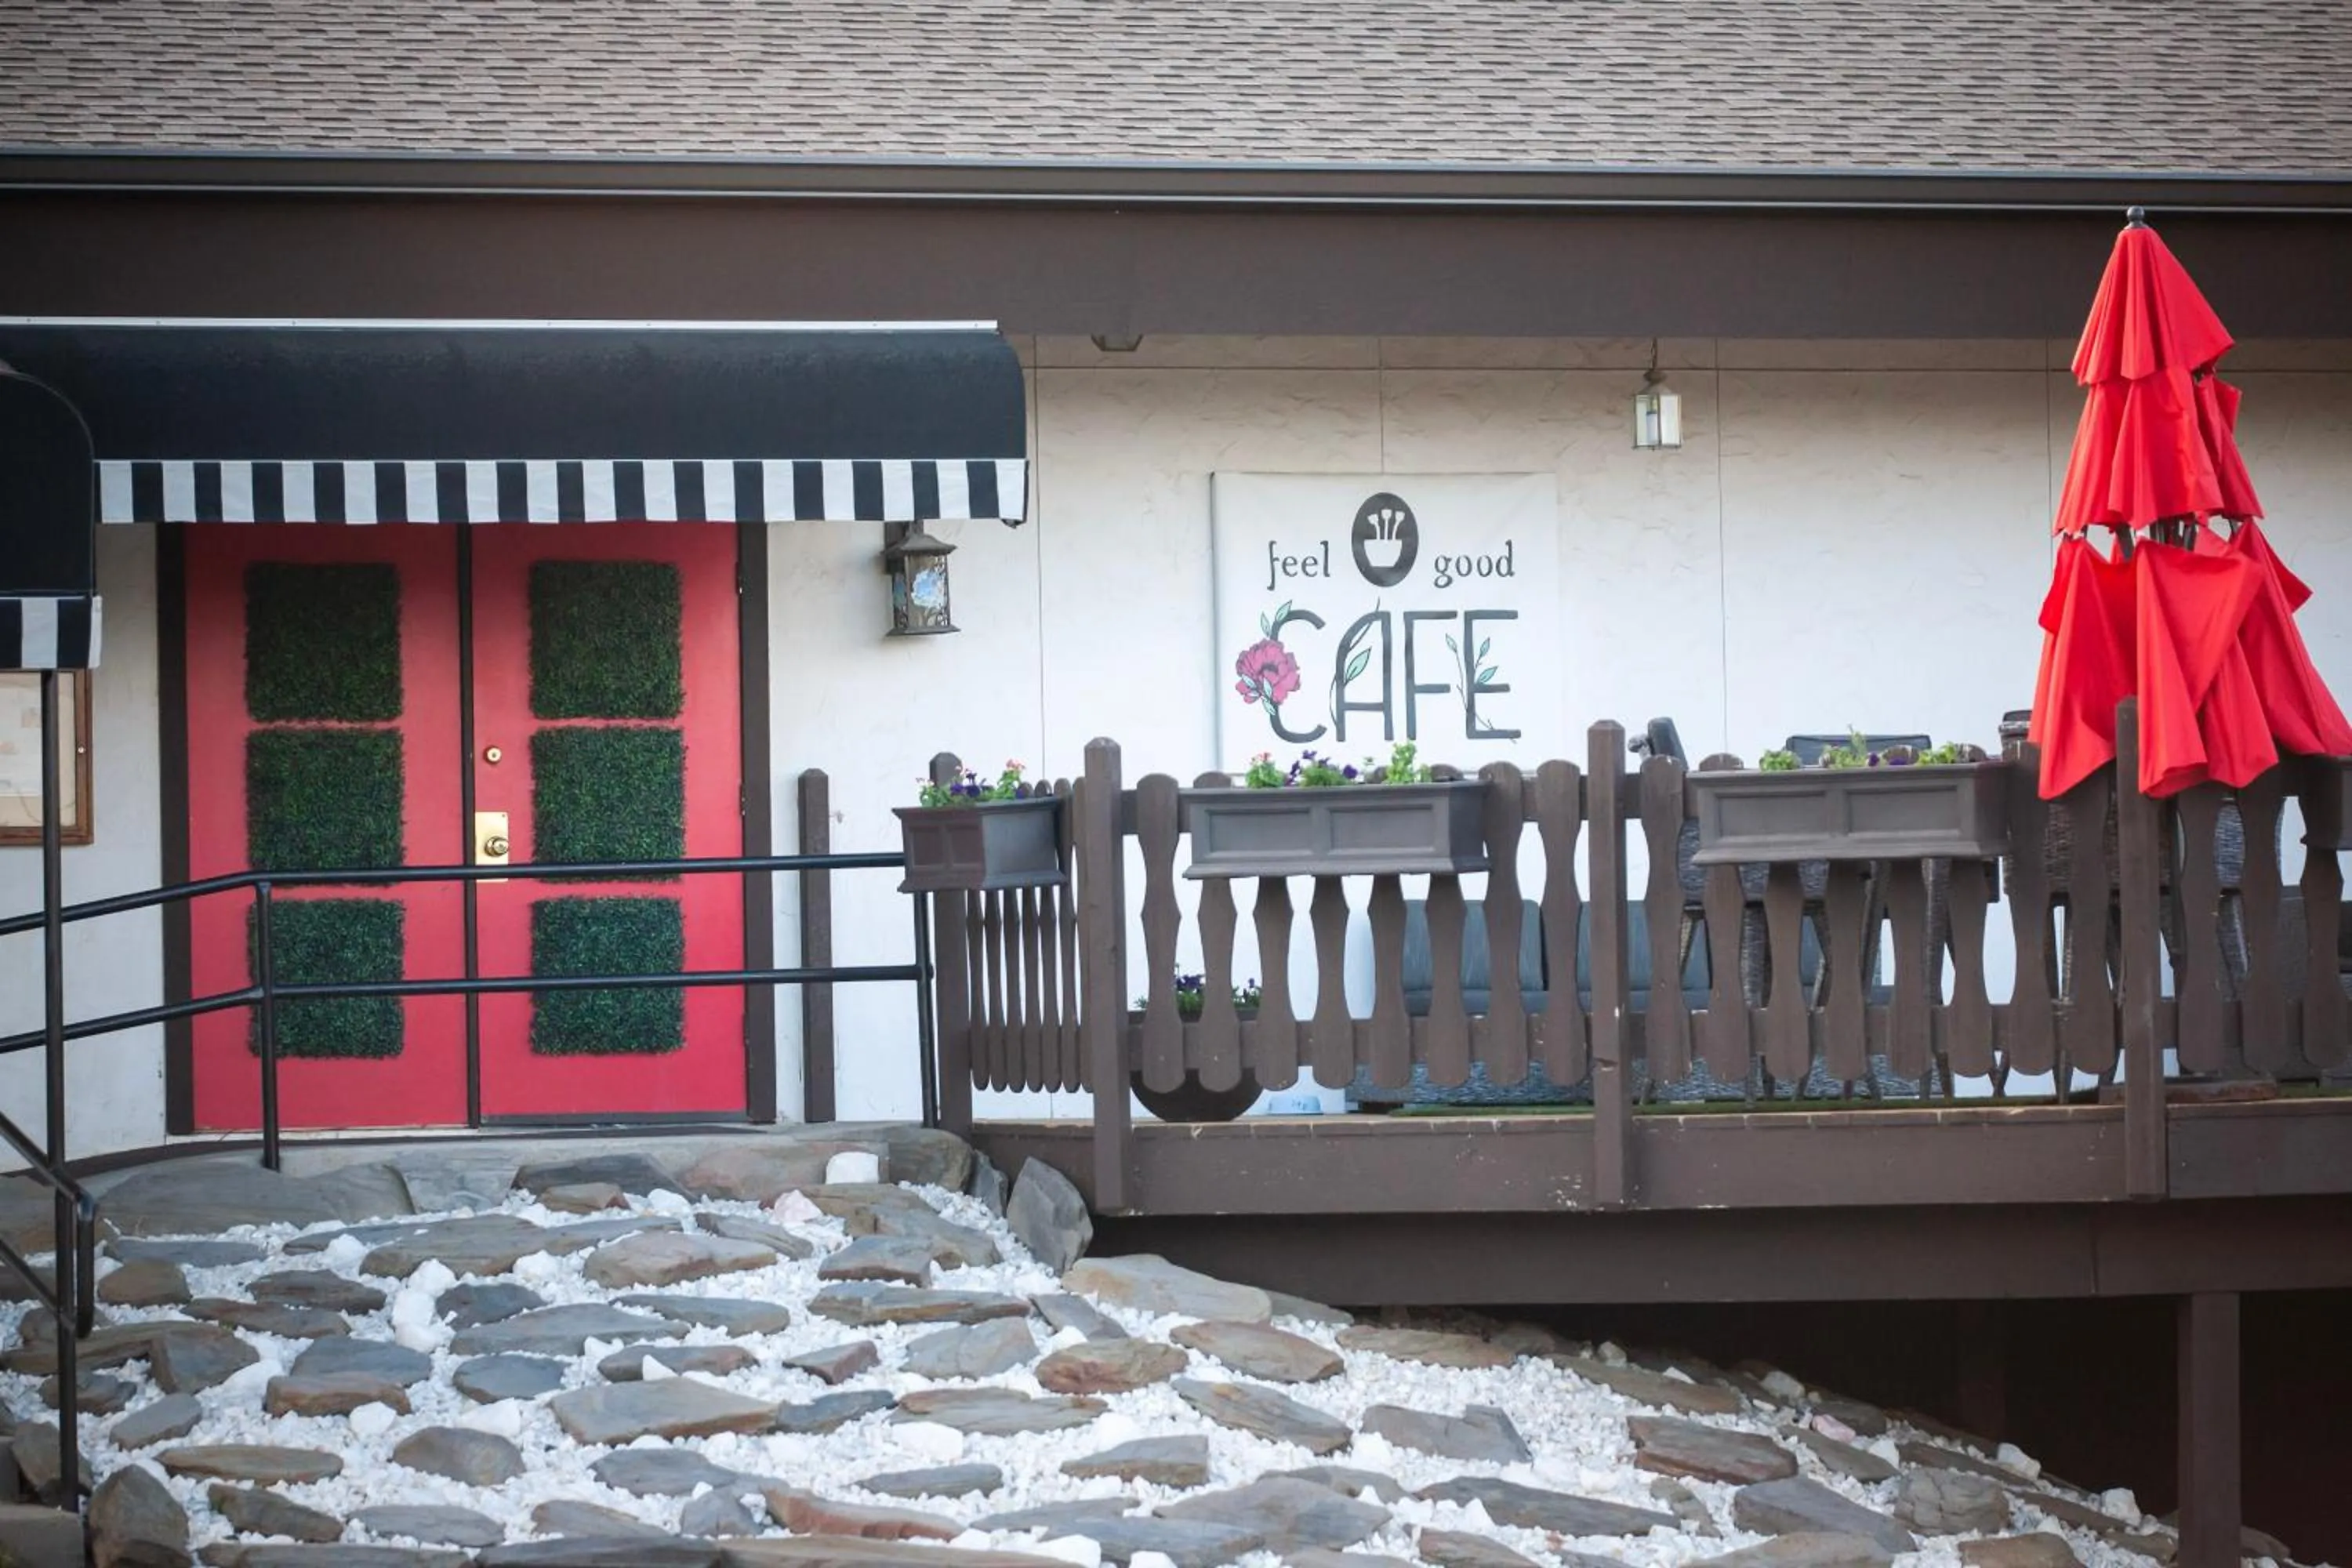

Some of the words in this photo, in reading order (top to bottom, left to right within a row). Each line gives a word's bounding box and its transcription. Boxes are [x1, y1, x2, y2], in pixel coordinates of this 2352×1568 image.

[1267, 540, 1330, 590] feel
[1433, 539, 1515, 589] good
[1268, 609, 1521, 743] CAFE
